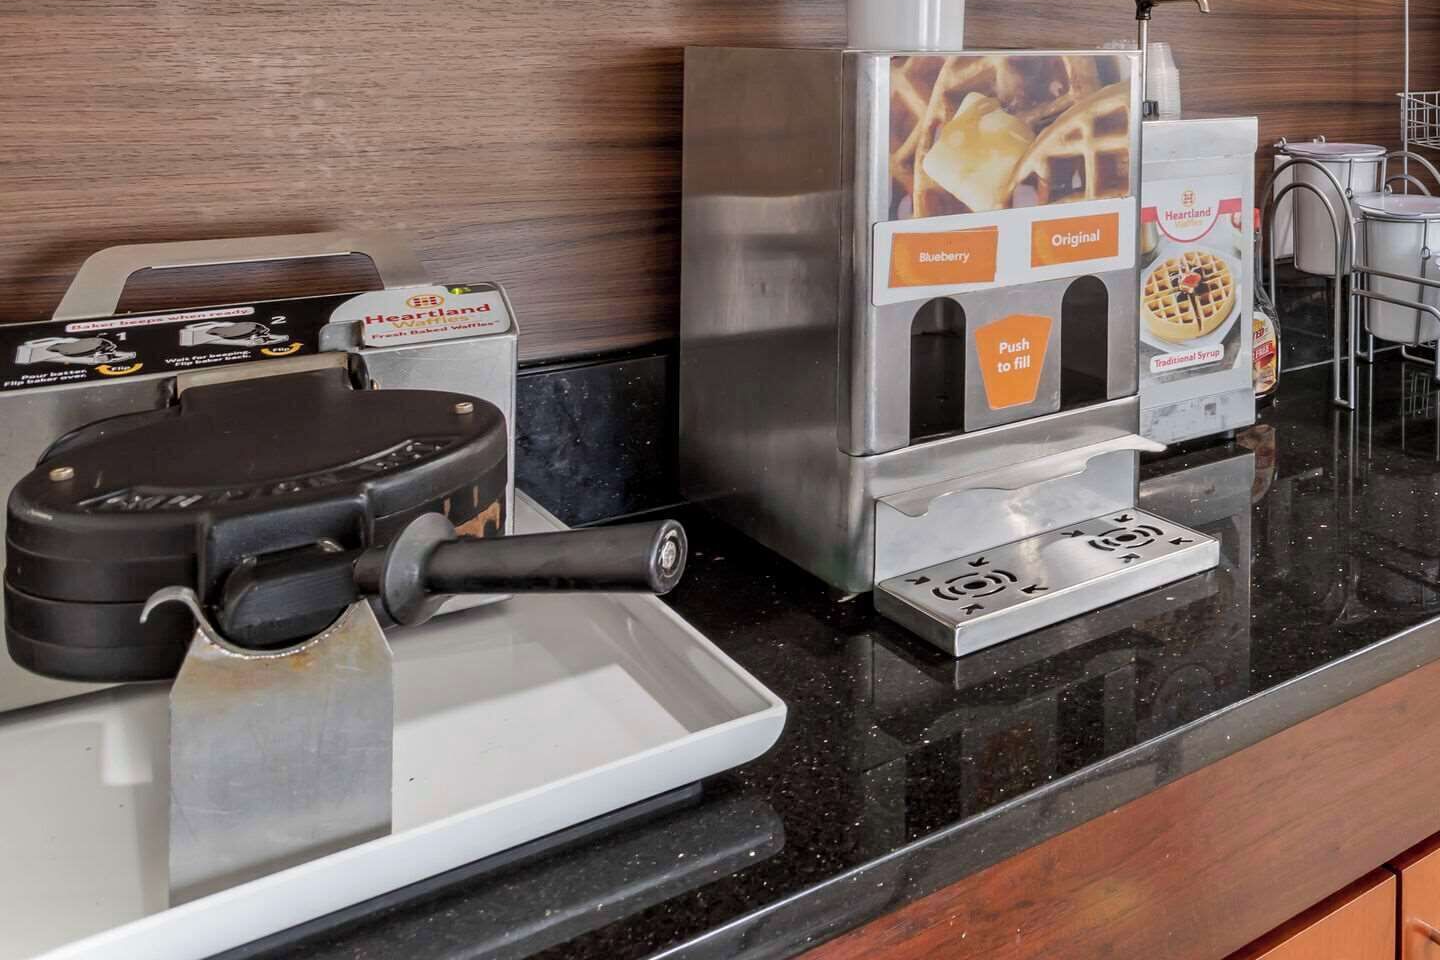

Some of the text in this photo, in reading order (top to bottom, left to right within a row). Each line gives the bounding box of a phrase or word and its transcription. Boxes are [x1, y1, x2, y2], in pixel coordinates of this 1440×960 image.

[1165, 207, 1211, 221] Heartland
[1051, 228, 1100, 248] Original
[919, 251, 970, 263] Blueberry
[270, 315, 288, 325] 2
[365, 303, 491, 325] Heartland
[72, 321, 114, 331] Baker
[119, 318, 163, 329] beeps
[167, 313, 207, 322] when
[392, 315, 470, 329] Waffles
[116, 331, 127, 341] 1
[371, 330, 408, 340] Fresh
[410, 326, 449, 336] Baked
[999, 337, 1030, 355] Push
[165, 356, 189, 364] Wait
[175, 359, 193, 367] Flip
[195, 356, 224, 365] baker
[997, 354, 1031, 373] to fill
[1154, 350, 1220, 368] Traditional Syrup
[4, 379, 25, 387] Flip
[27, 375, 57, 385] baker
[22, 372, 49, 381] Pour
